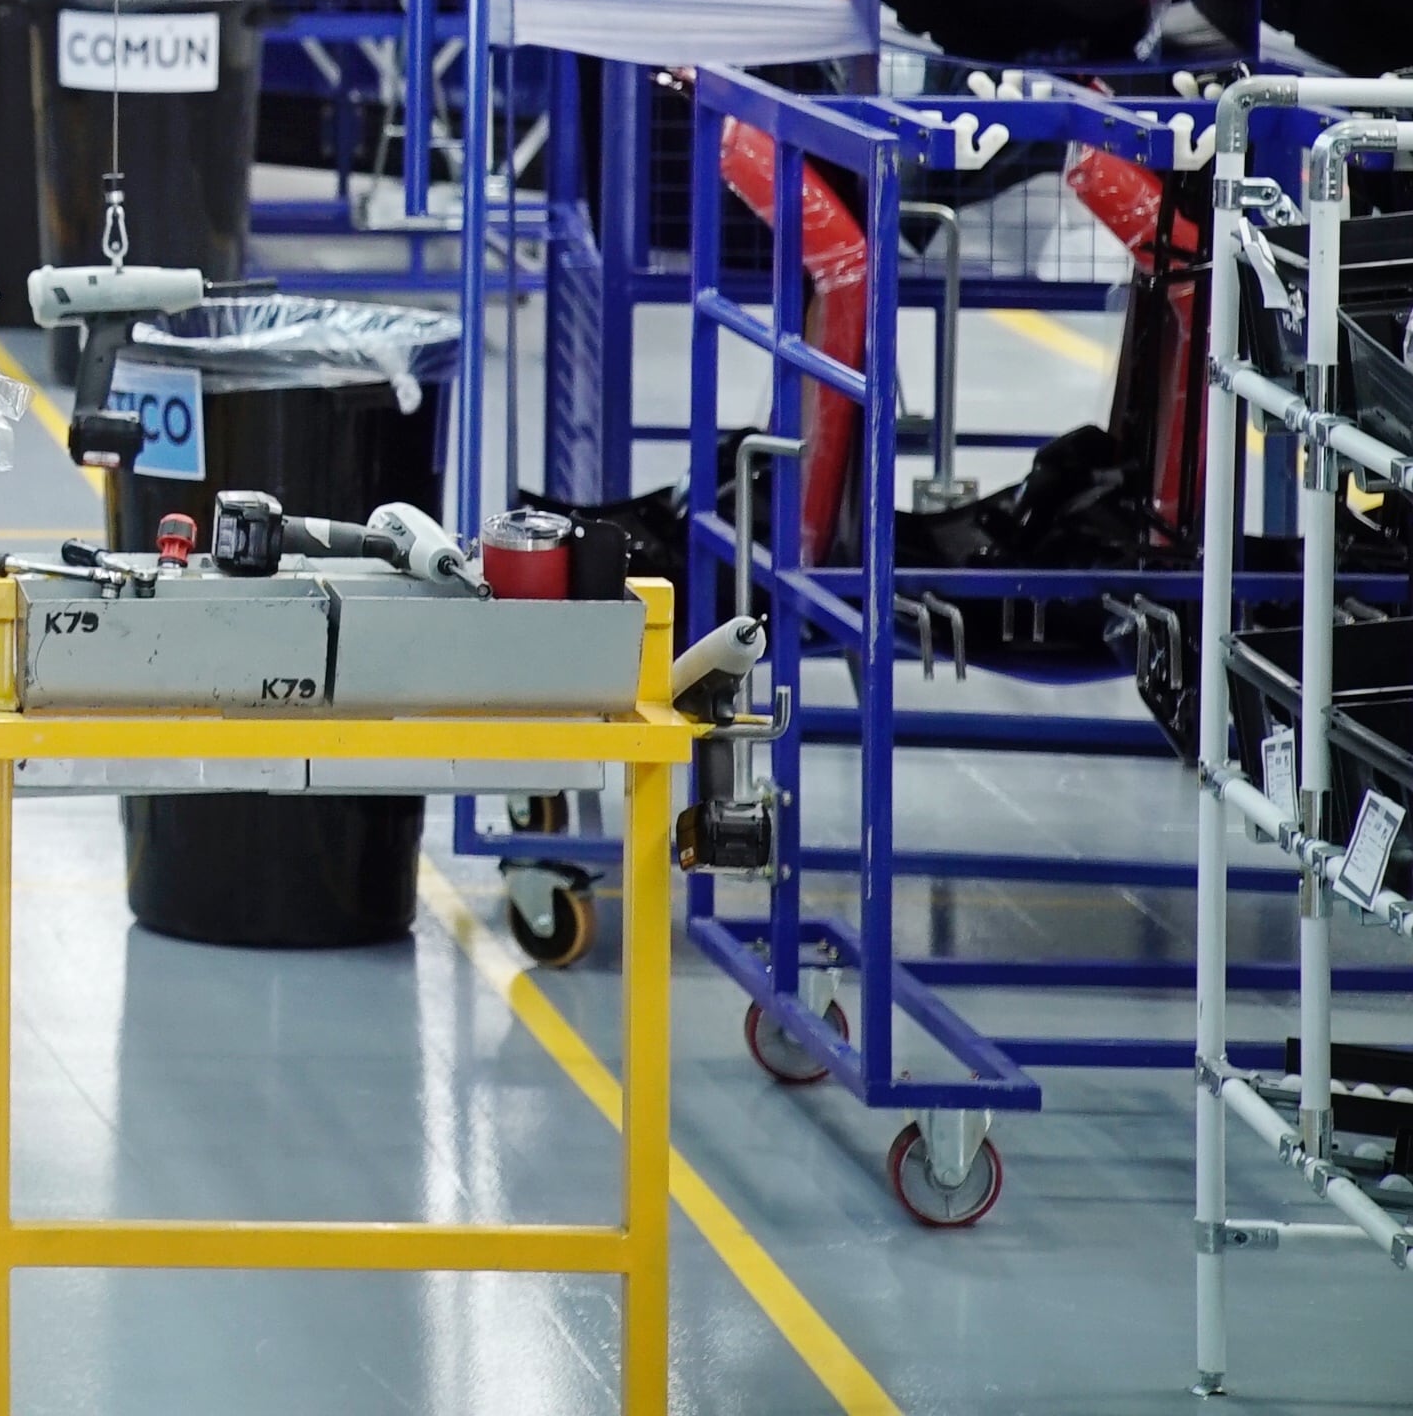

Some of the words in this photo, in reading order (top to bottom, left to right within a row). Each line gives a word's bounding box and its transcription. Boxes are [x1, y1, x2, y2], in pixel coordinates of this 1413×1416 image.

[67, 23, 209, 69] COMÚN
[45, 611, 99, 634] K79
[262, 678, 316, 700] K79
